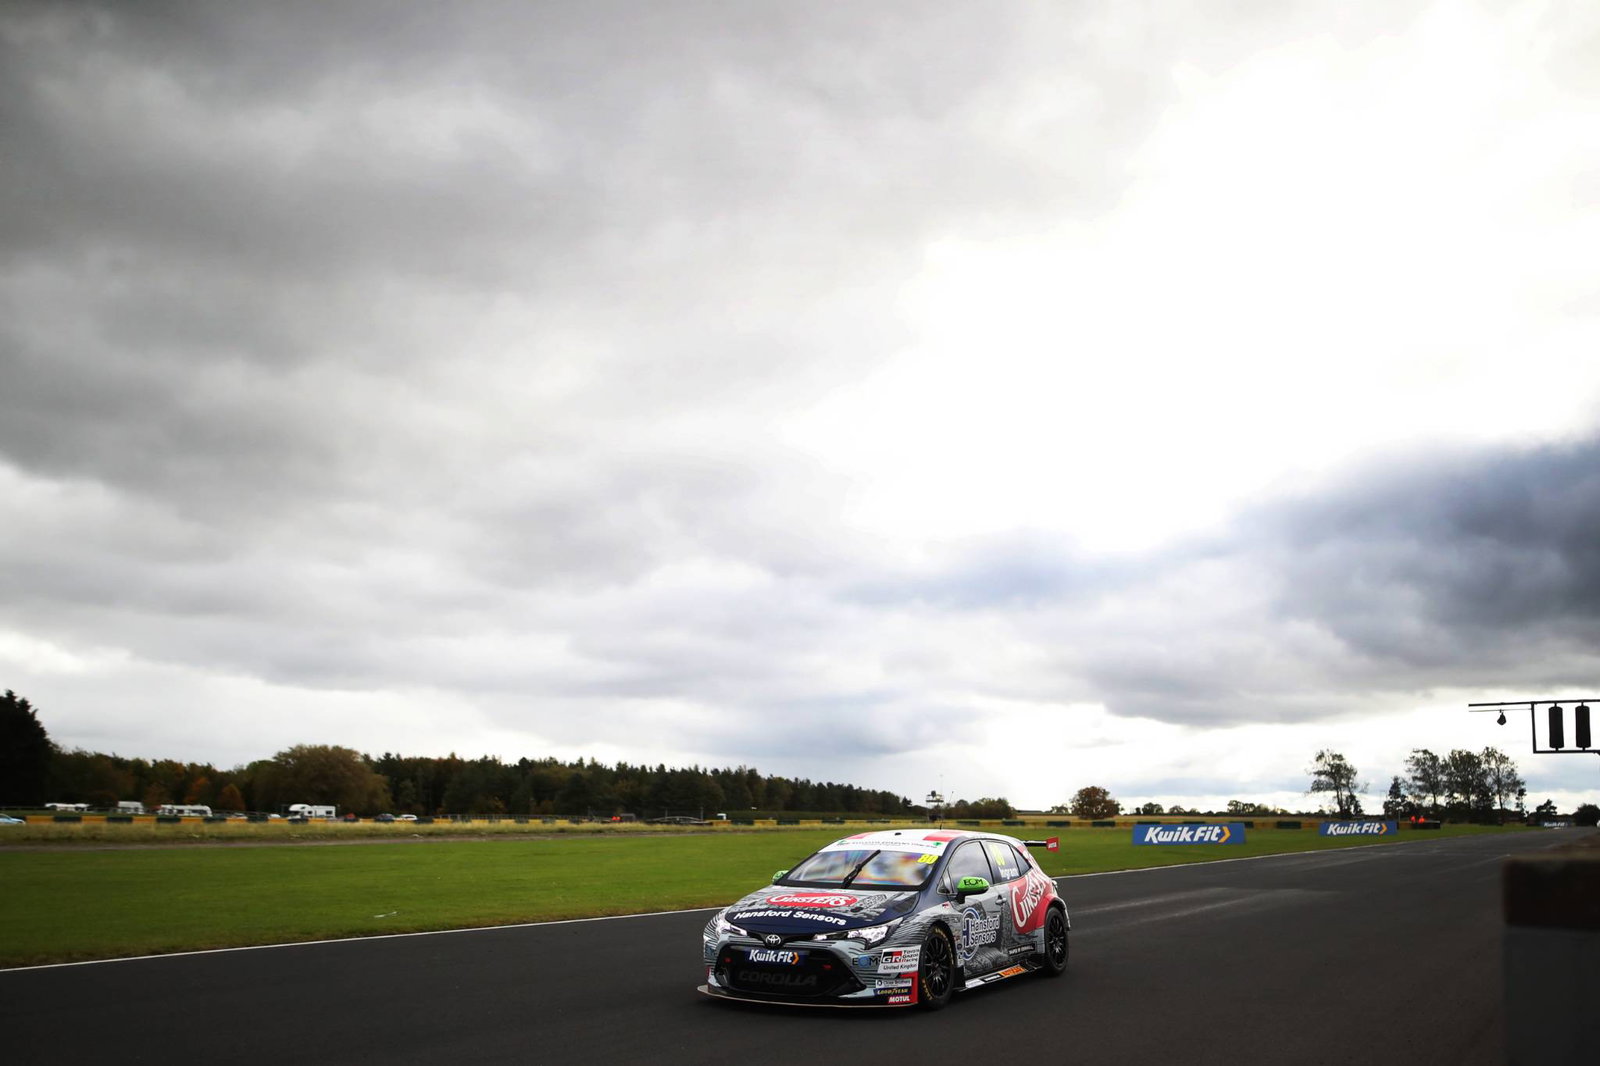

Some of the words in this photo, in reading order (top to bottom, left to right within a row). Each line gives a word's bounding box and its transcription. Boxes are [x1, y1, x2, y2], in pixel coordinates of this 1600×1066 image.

[917, 853, 939, 865] 80
[734, 910, 792, 920] Hansford
[793, 911, 847, 926] Sensors
[970, 914, 999, 932] Hansford
[970, 931, 996, 946] Sensors
[738, 970, 817, 986] COROLLA
[888, 995, 910, 1003] MOTUL
